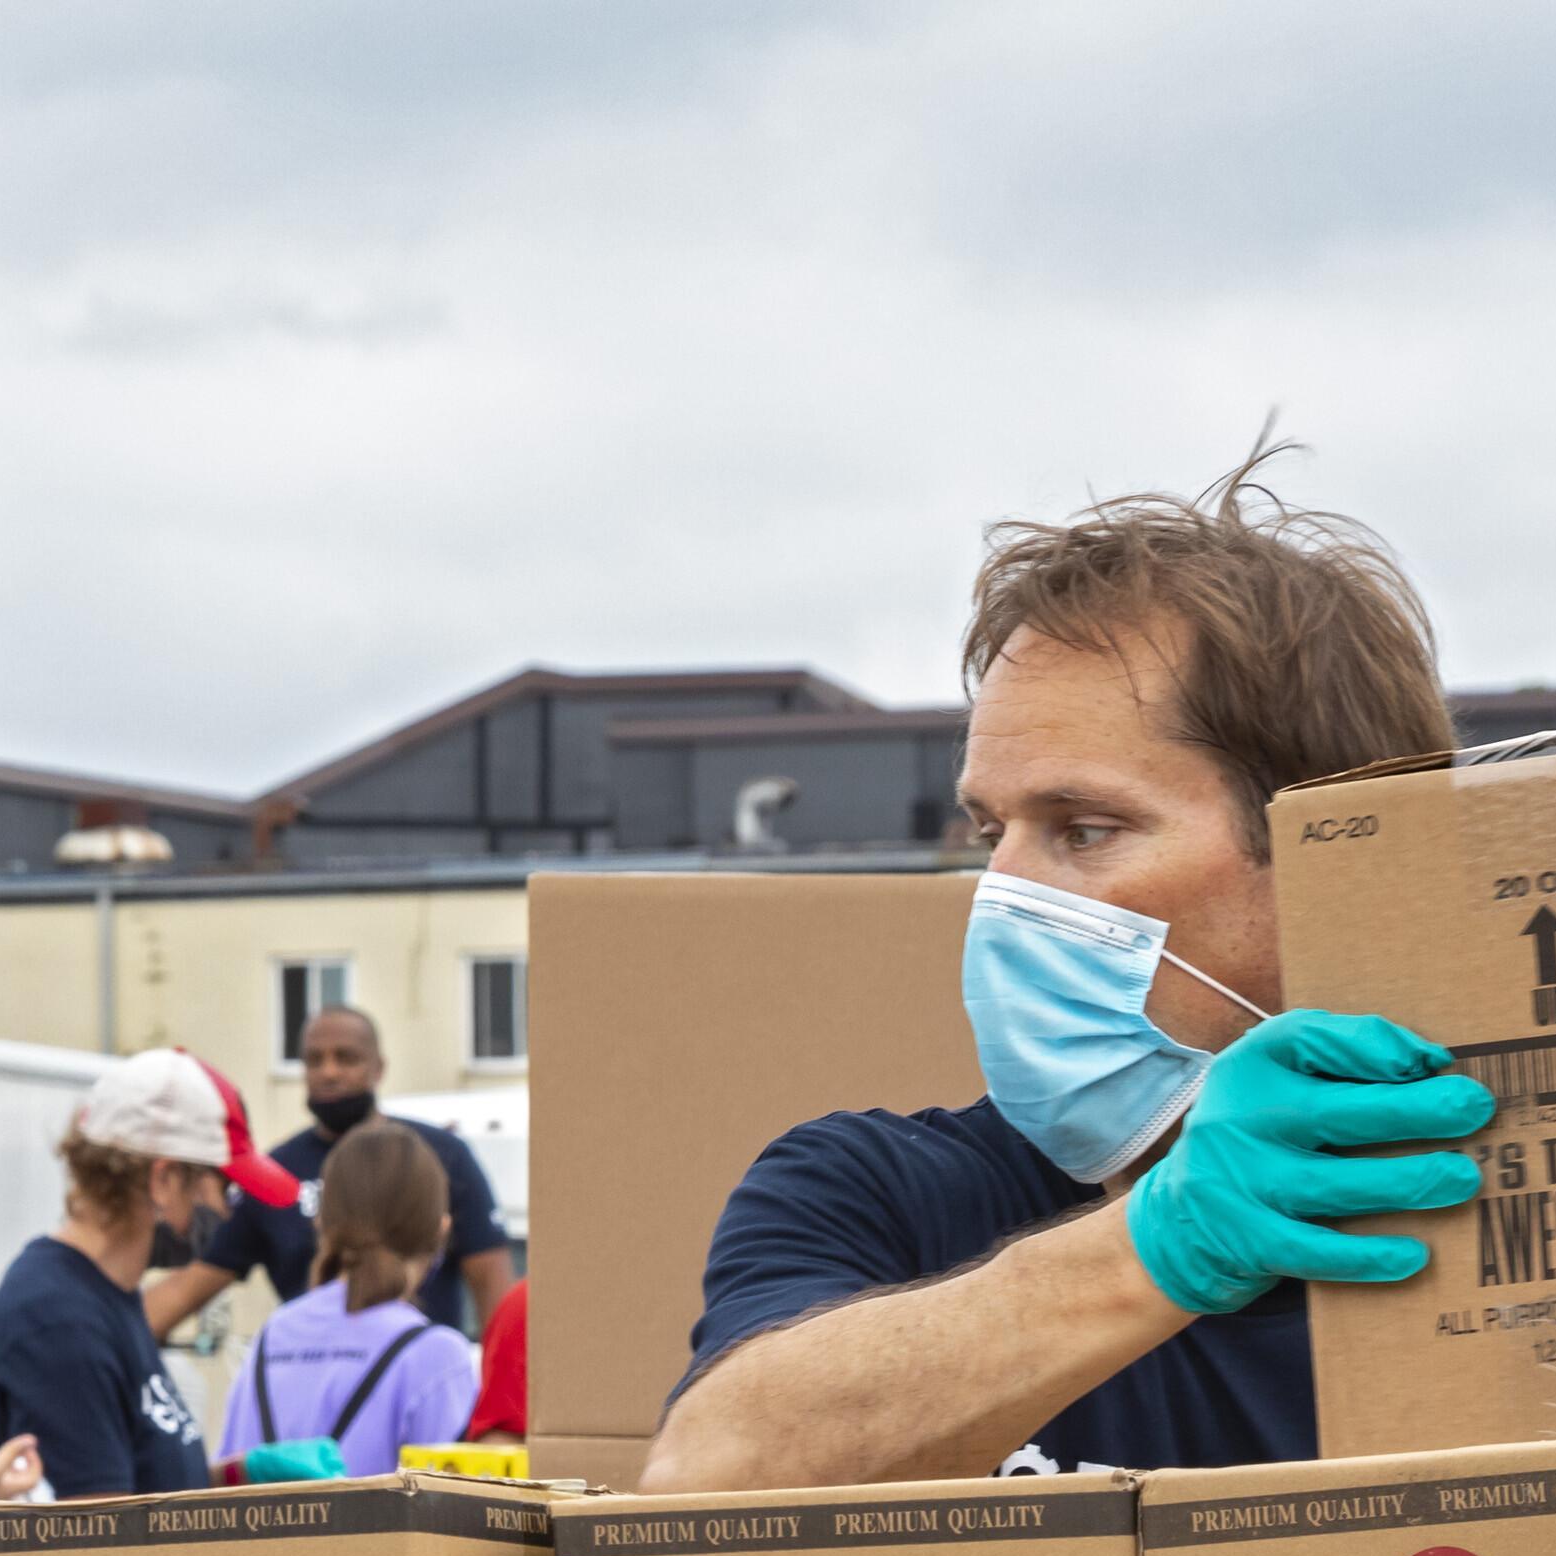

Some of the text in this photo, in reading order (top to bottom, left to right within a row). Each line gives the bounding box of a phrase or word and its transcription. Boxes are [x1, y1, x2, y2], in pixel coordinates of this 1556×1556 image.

[1300, 816, 1379, 844] AC-20
[1493, 873, 1530, 900] 20
[35, 1514, 119, 1542] QUALITY
[595, 1516, 801, 1546] PREMIUM QUALITY
